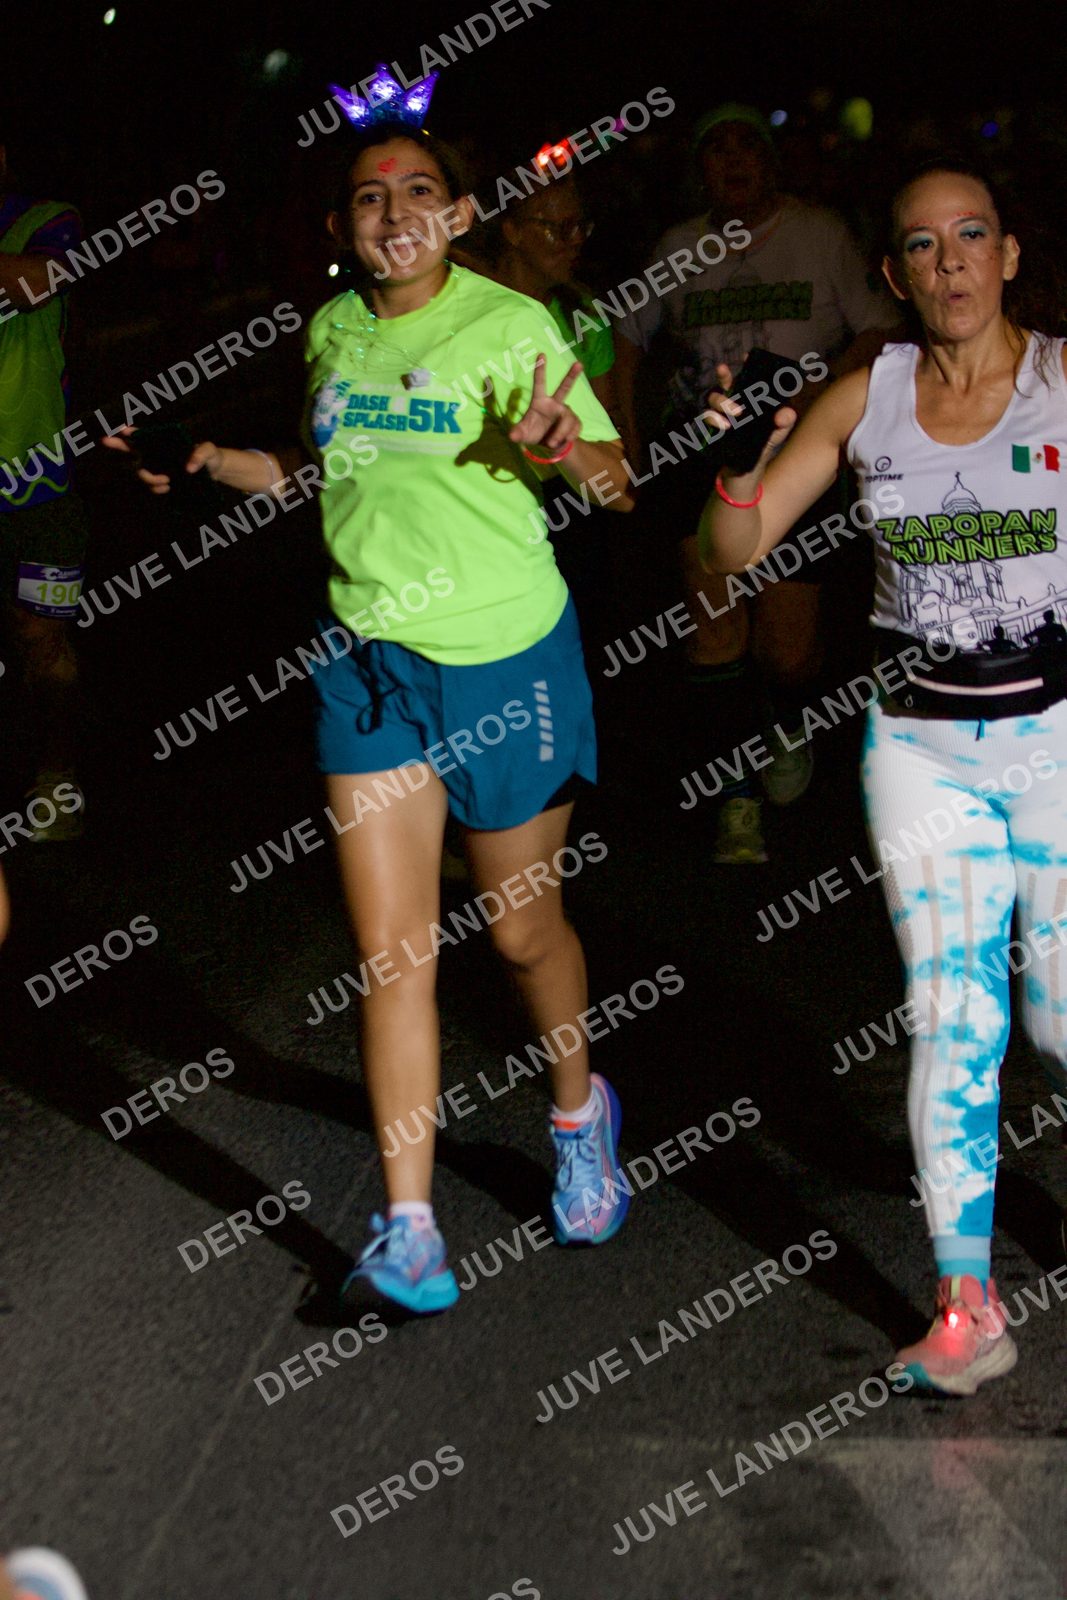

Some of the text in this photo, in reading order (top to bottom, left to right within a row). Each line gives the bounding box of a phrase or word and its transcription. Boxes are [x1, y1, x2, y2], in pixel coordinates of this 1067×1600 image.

[347, 393, 390, 411] DASH
[408, 397, 462, 434] 5K
[342, 411, 408, 432] SPLASH
[876, 508, 1057, 543] ZAPOPAN
